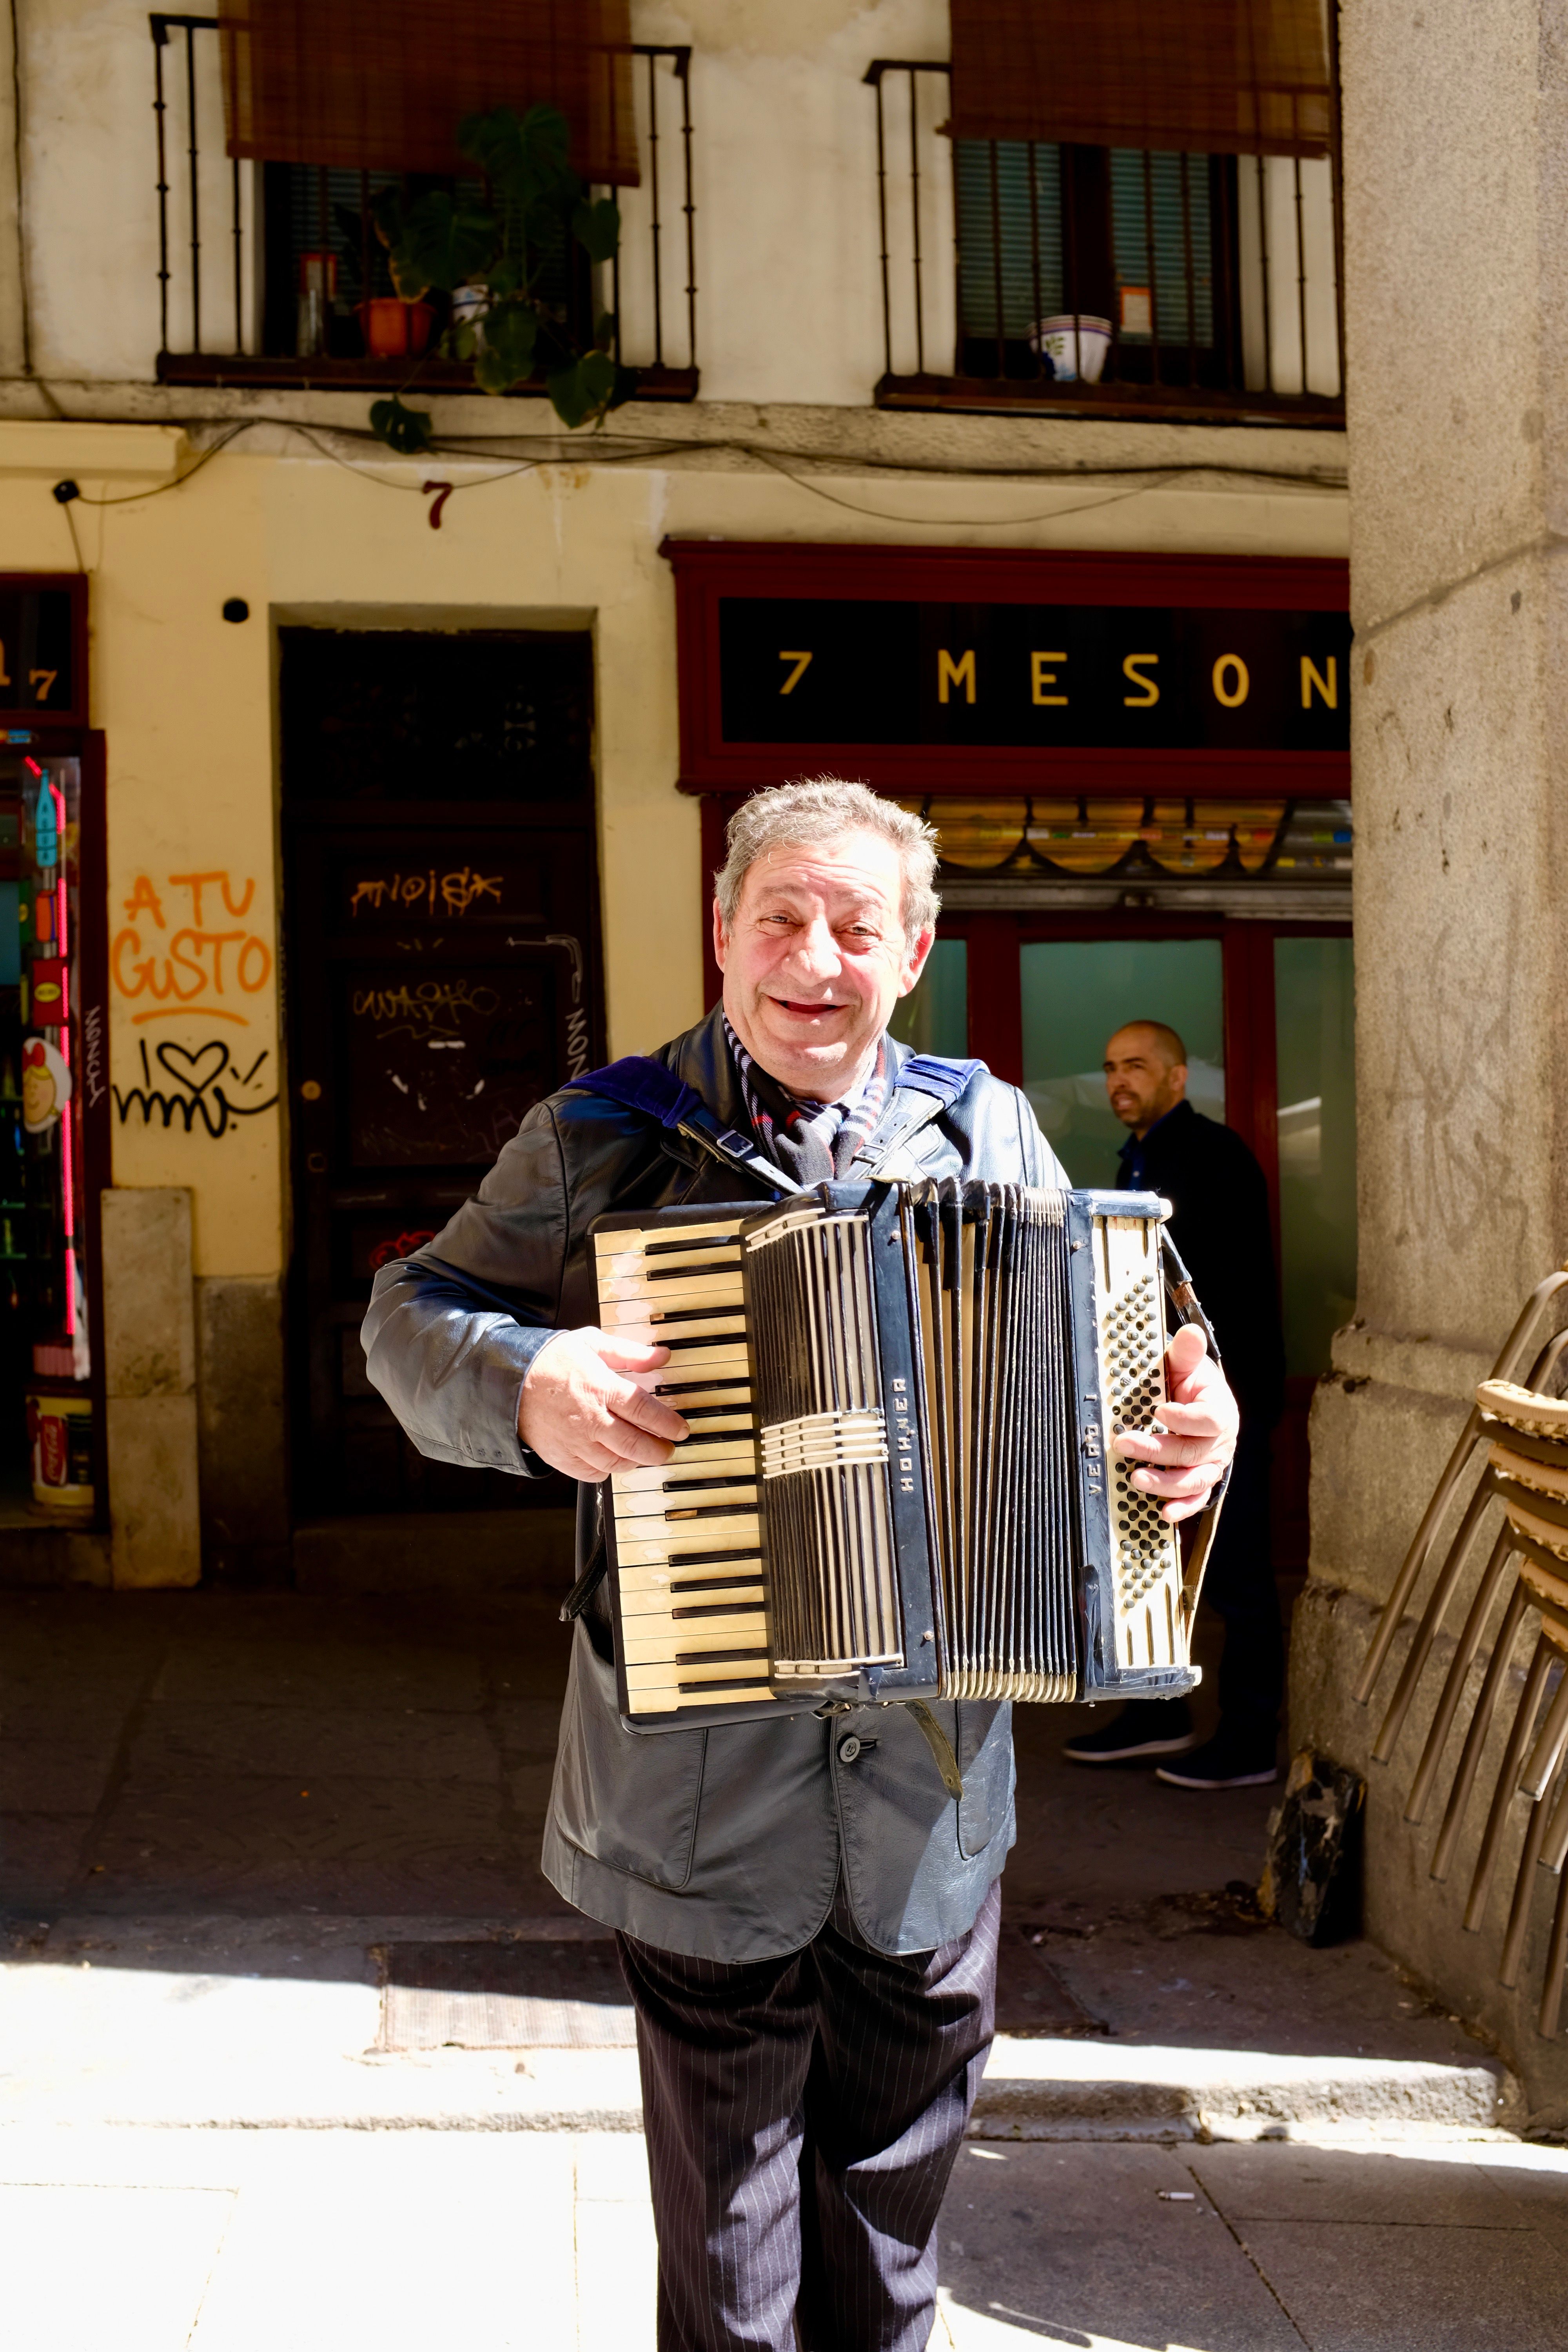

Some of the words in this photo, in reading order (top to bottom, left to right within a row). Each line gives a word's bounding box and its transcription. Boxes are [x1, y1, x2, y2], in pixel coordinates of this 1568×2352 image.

[422, 481, 454, 529] 7
[29, 668, 58, 702] 7
[779, 651, 813, 695] 7
[937, 649, 1338, 709] MESON
[892, 1378, 914, 1492] HOHNER
